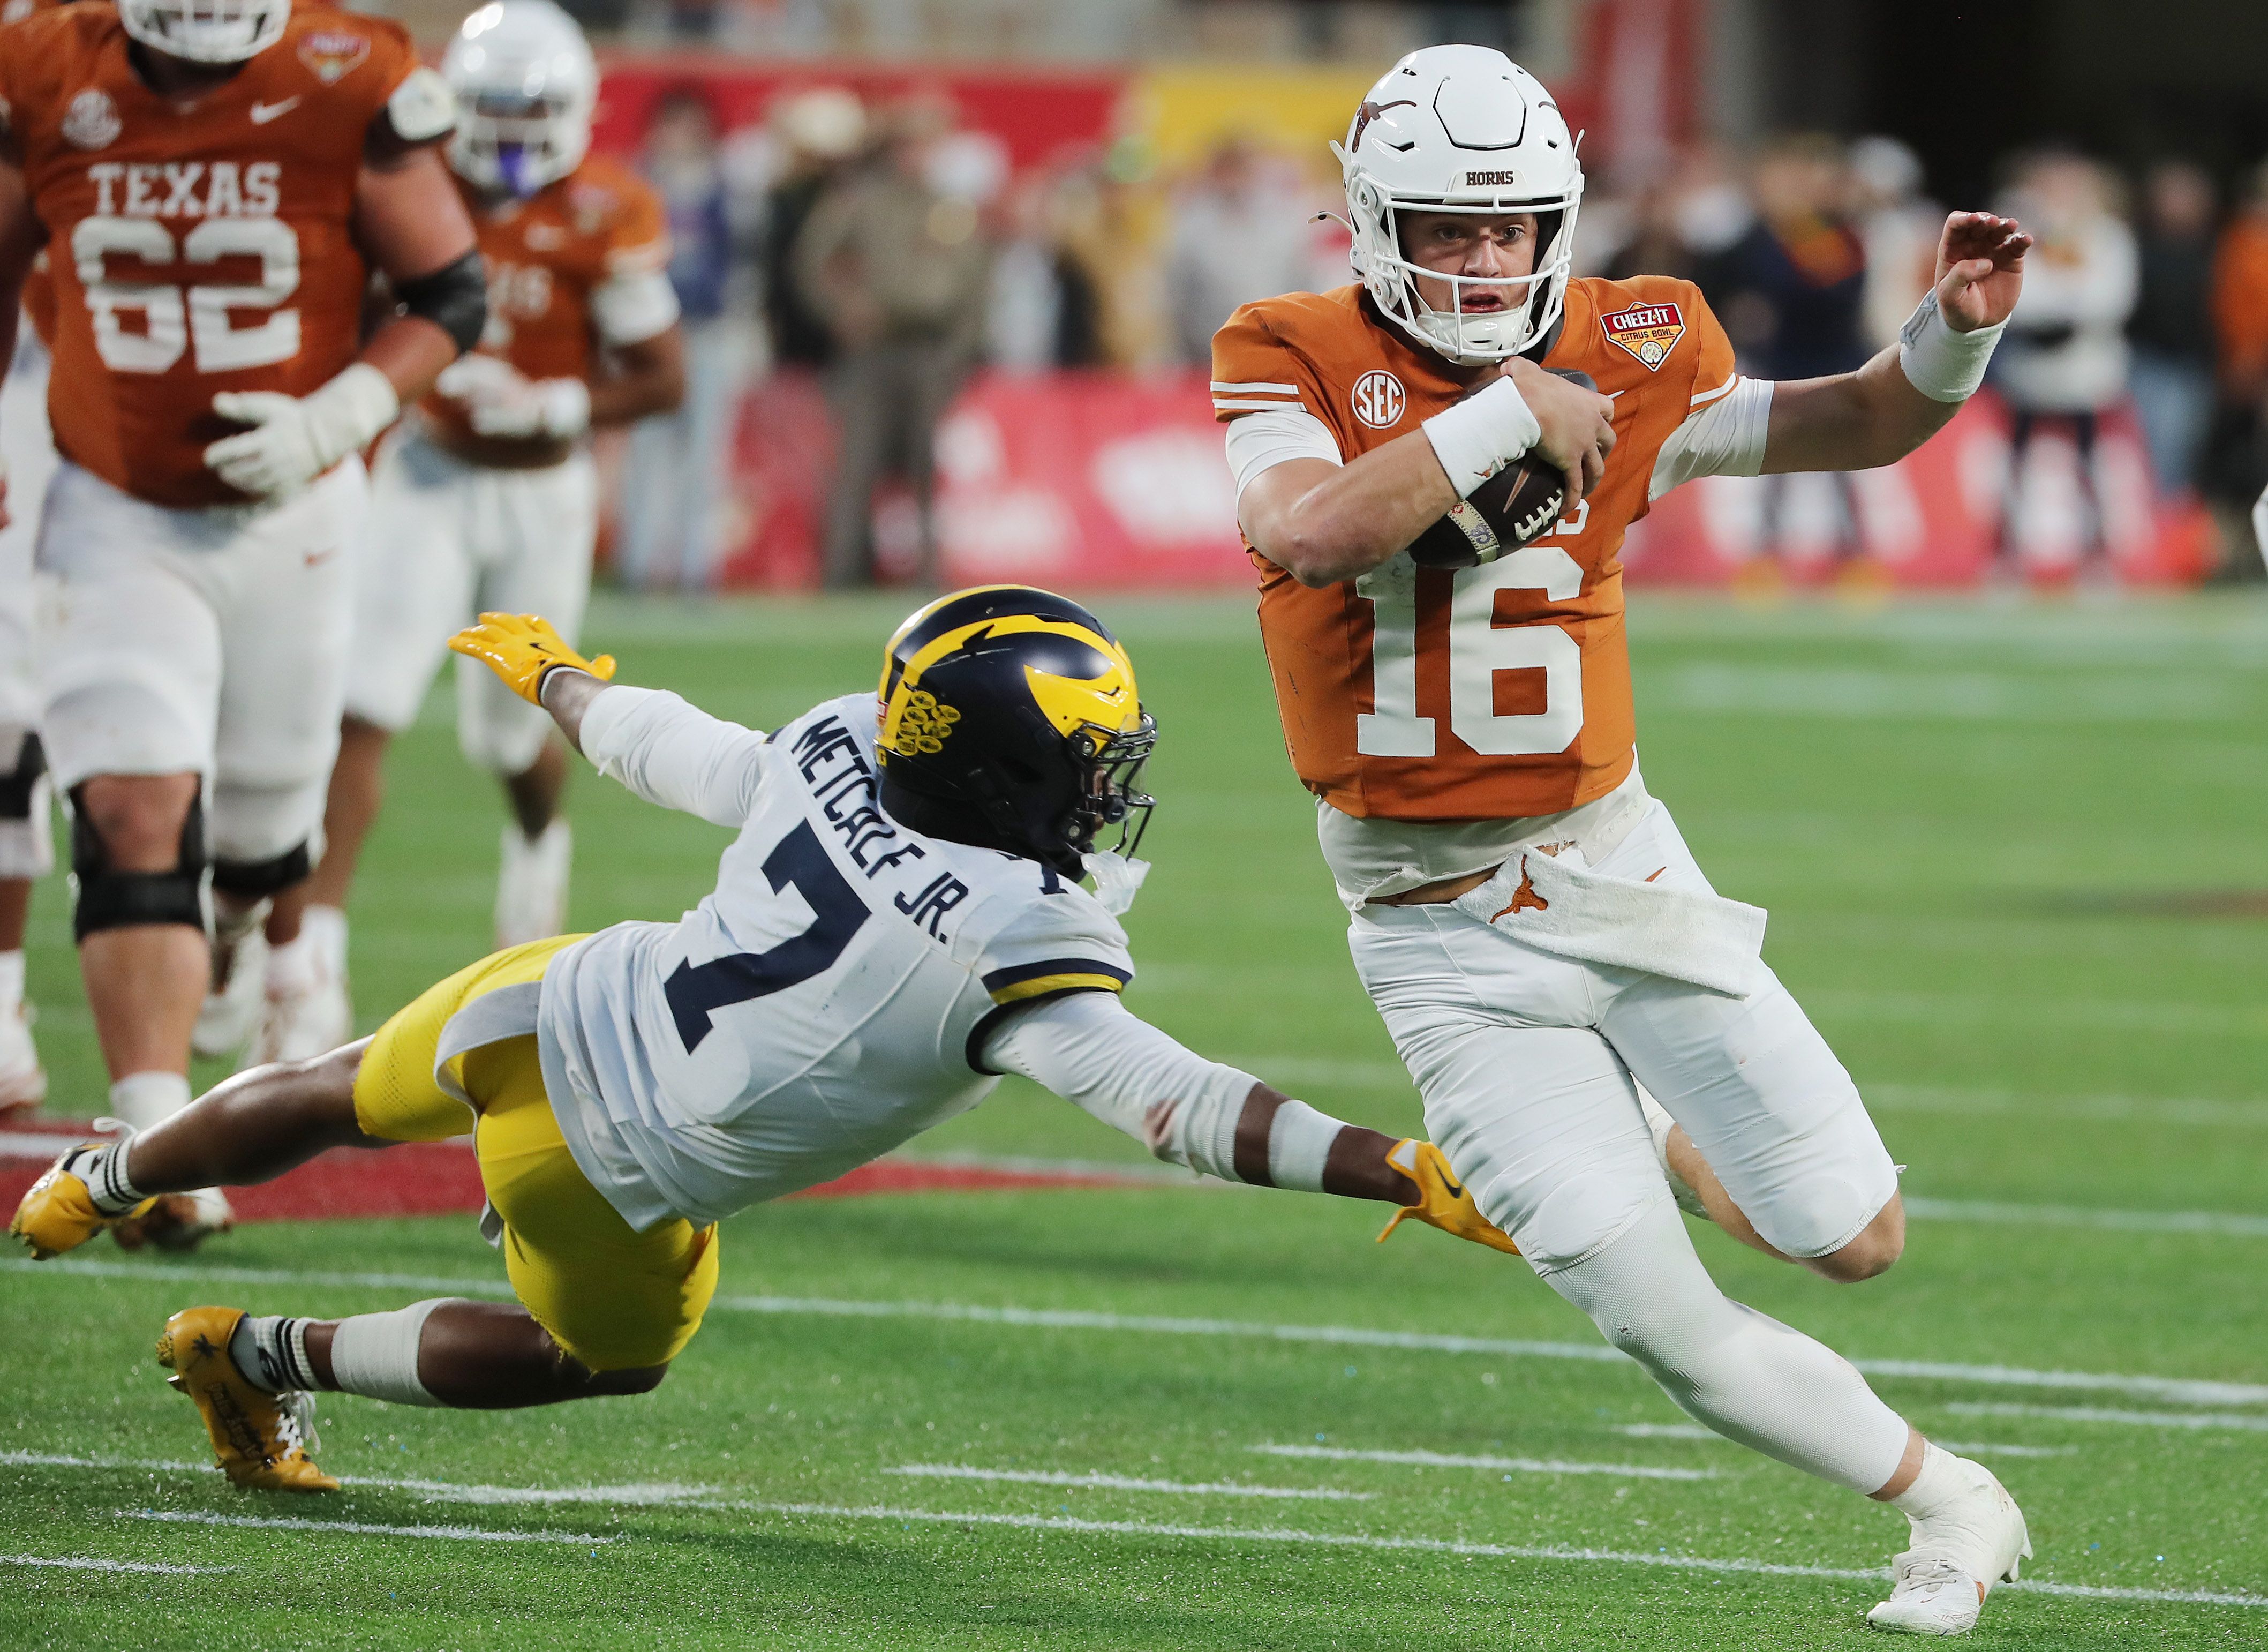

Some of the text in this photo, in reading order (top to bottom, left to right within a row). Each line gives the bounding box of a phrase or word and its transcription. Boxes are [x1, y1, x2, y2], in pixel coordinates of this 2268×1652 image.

[88, 162, 282, 215] TEXAS
[1466, 171, 1513, 185] HORNS
[71, 215, 300, 374] 62
[1621, 328, 1675, 341] CITRUS BOWL
[1357, 374, 1400, 424] SEC
[1356, 546, 1585, 757] 16
[792, 714, 969, 945] METCALF JR.
[664, 816, 872, 1056] 7
